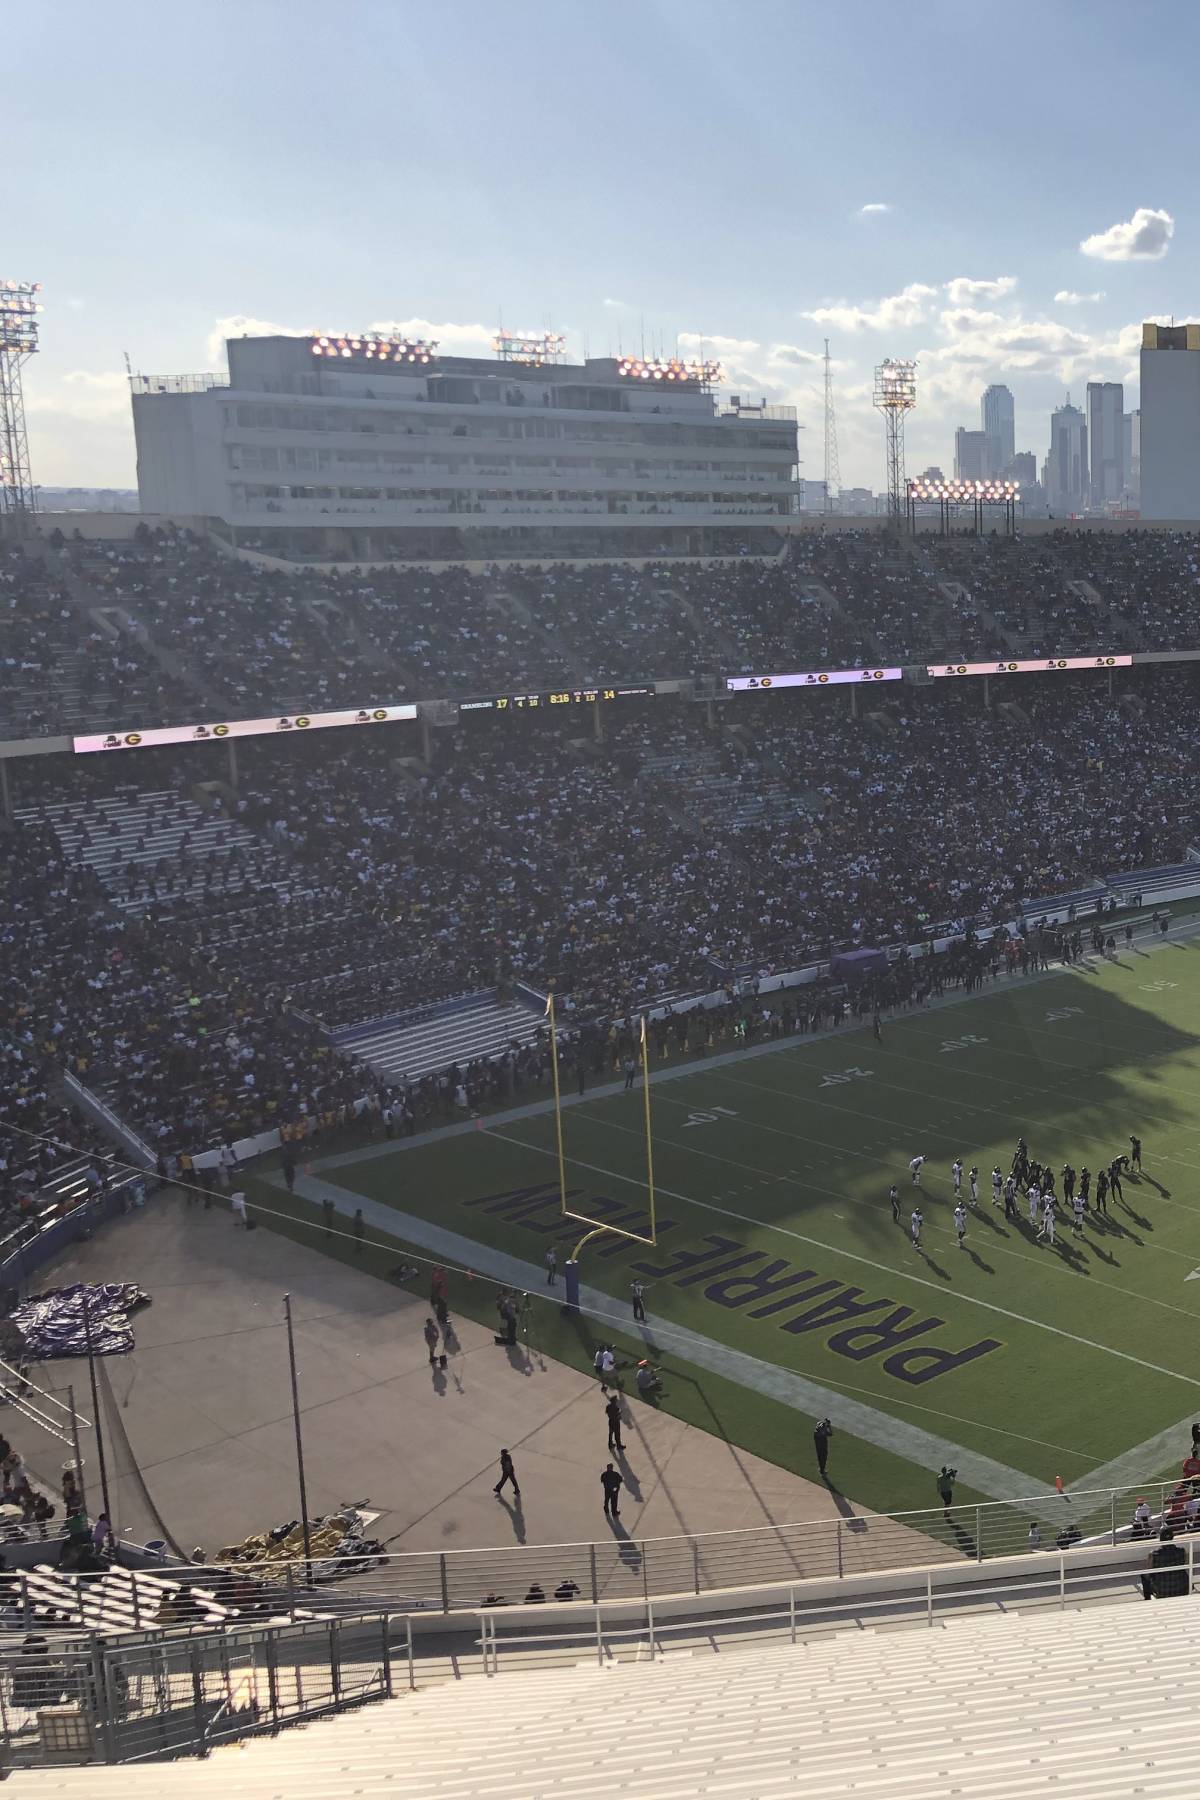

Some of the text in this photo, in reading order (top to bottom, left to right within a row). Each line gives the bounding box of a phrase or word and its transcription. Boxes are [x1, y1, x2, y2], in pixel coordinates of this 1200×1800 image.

[603, 690, 616, 699] 14
[496, 699, 508, 709] 17
[373, 709, 387, 720] G
[295, 717, 310, 728] G
[213, 724, 229, 736] G
[125, 733, 142, 745] G
[822, 1066, 874, 1083] 20
[687, 1105, 738, 1122] 10
[462, 1181, 1003, 1386] PRAIRIE VIEW
